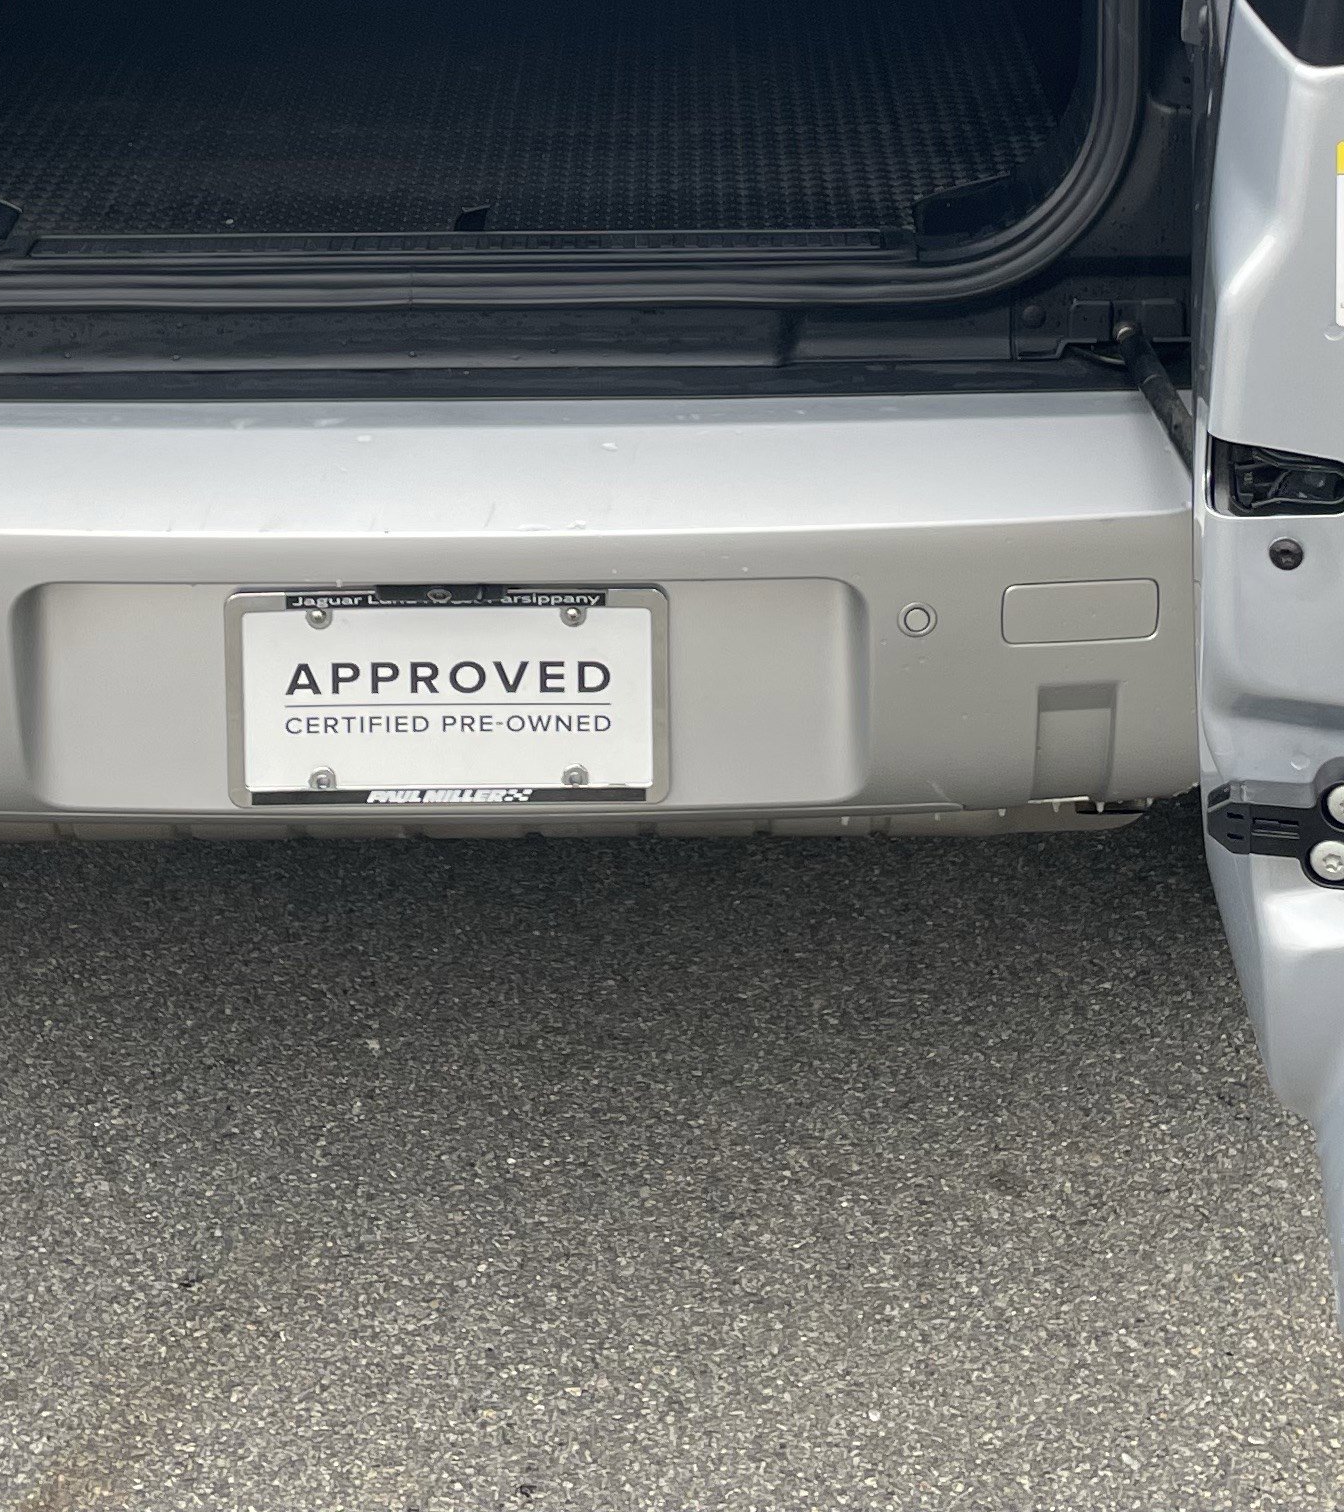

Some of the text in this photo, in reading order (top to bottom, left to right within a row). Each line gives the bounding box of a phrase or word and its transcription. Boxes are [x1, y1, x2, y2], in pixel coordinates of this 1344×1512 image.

[292, 595, 362, 608] Jaguar
[488, 593, 600, 606] arsippany
[285, 661, 611, 695] APPROVED
[285, 714, 612, 734] CERTIFIED PRE-OWNED
[367, 789, 506, 803] PAUL MILLER
